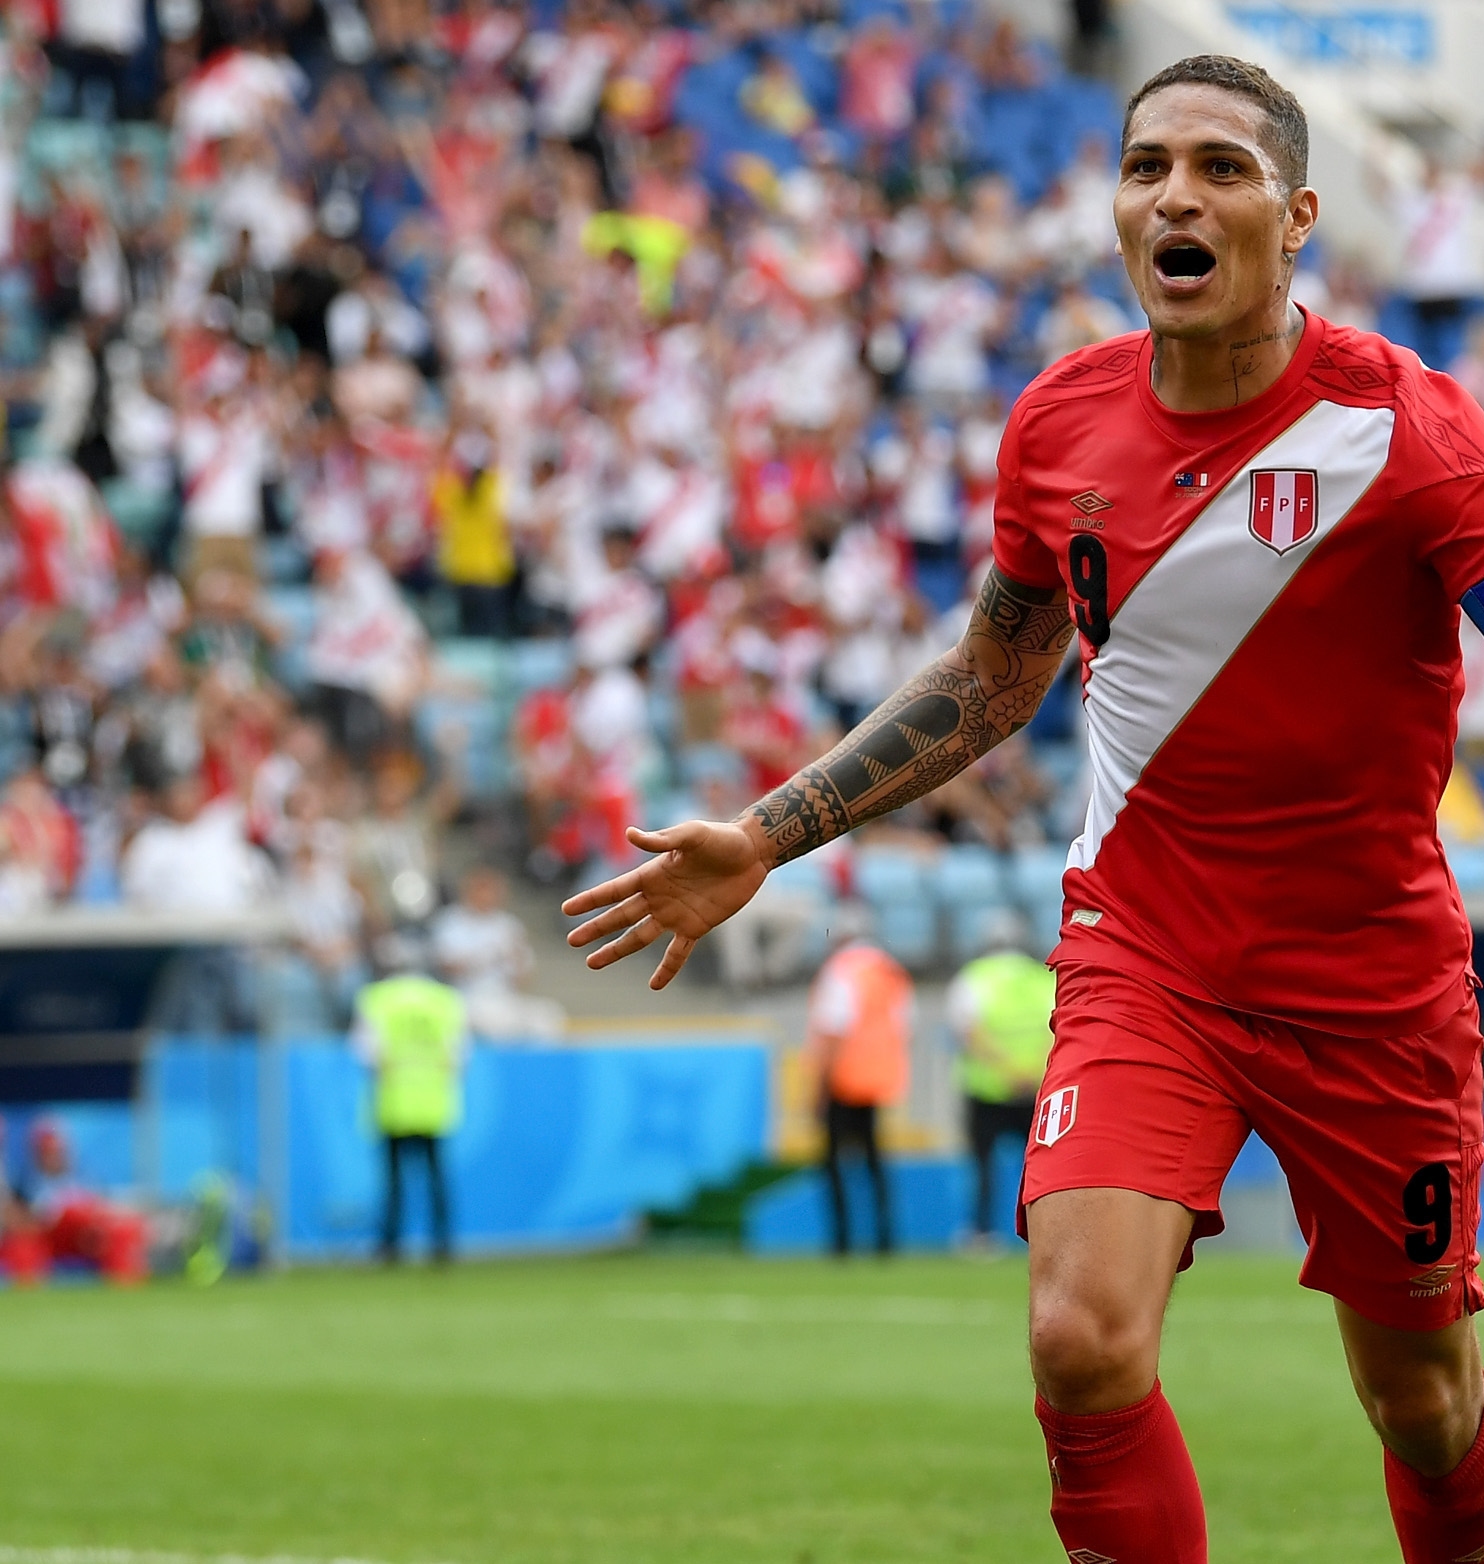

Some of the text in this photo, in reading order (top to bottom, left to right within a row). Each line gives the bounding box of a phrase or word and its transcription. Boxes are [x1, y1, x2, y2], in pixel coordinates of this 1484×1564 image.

[1259, 496, 1310, 513] FPF
[1070, 516, 1105, 530] umbro
[1068, 533, 1111, 646] 9
[1402, 1162, 1453, 1265] 9
[1409, 1281, 1452, 1298] umbro
